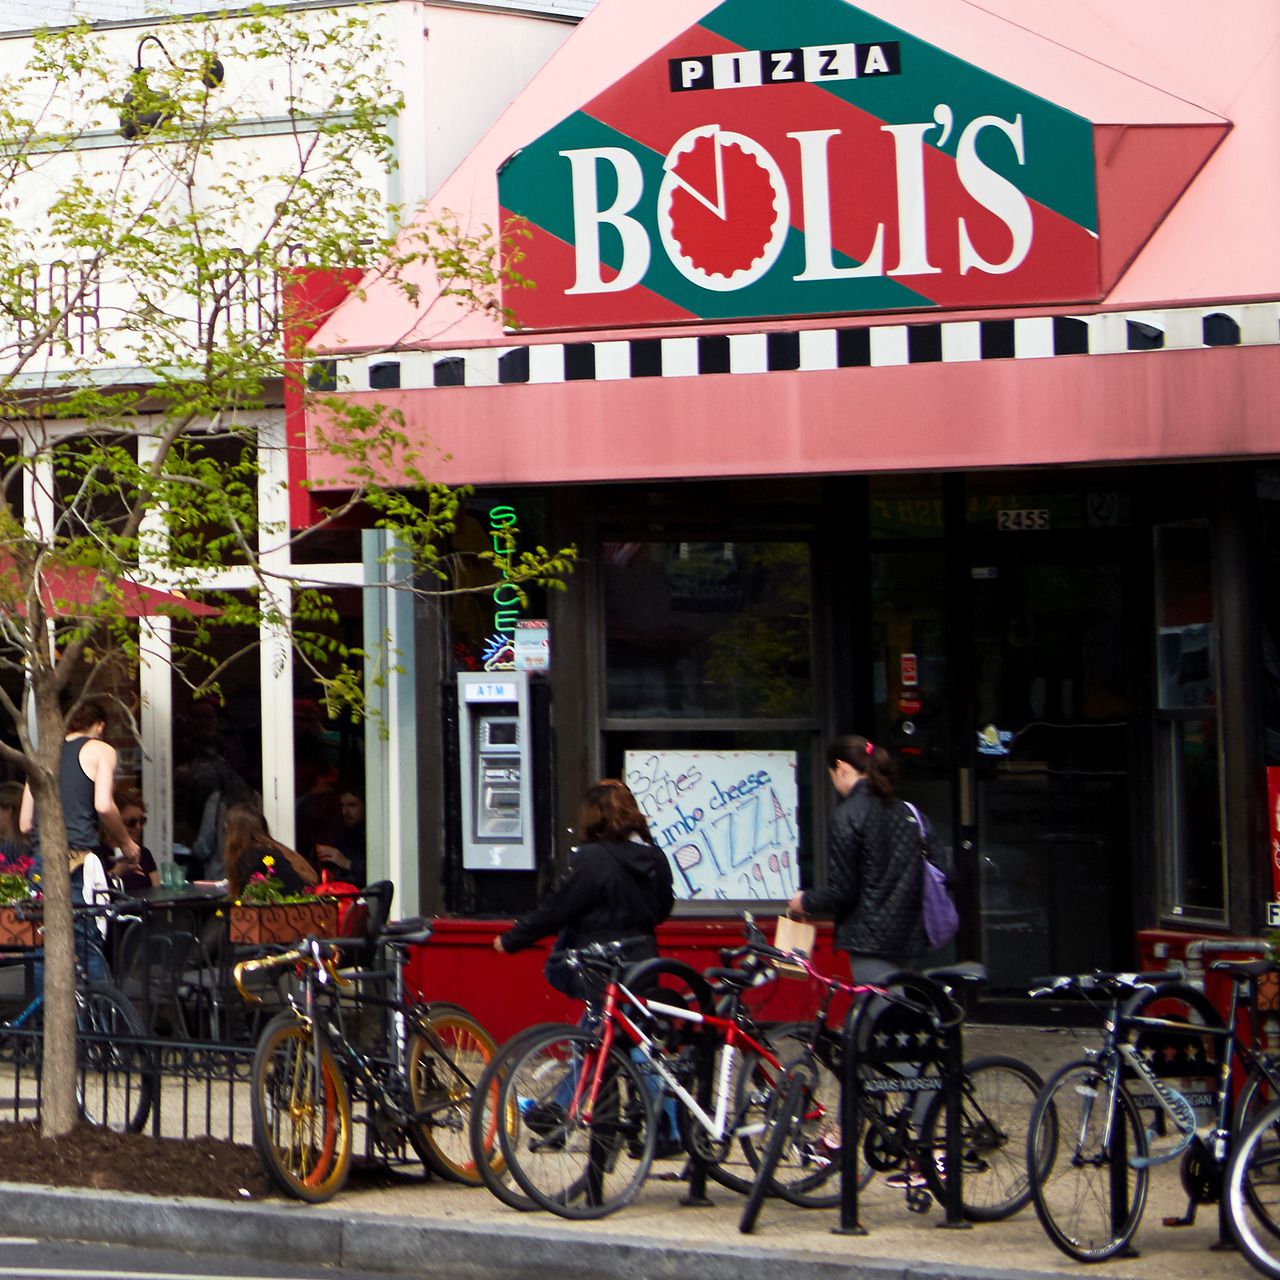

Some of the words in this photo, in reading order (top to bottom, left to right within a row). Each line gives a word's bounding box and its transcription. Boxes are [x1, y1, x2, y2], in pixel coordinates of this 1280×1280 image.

[681, 45, 888, 88] PIZZA
[559, 104, 1033, 292] BOLI'S
[1000, 511, 1047, 528] 2455
[477, 685, 504, 696] ATM
[627, 755, 660, 796] 32
[641, 765, 703, 818] nches
[709, 770, 772, 811] cheese
[672, 785, 796, 900] PIZZA
[864, 1078, 899, 1092] ADAMS
[900, 1077, 942, 1091] MORGAN
